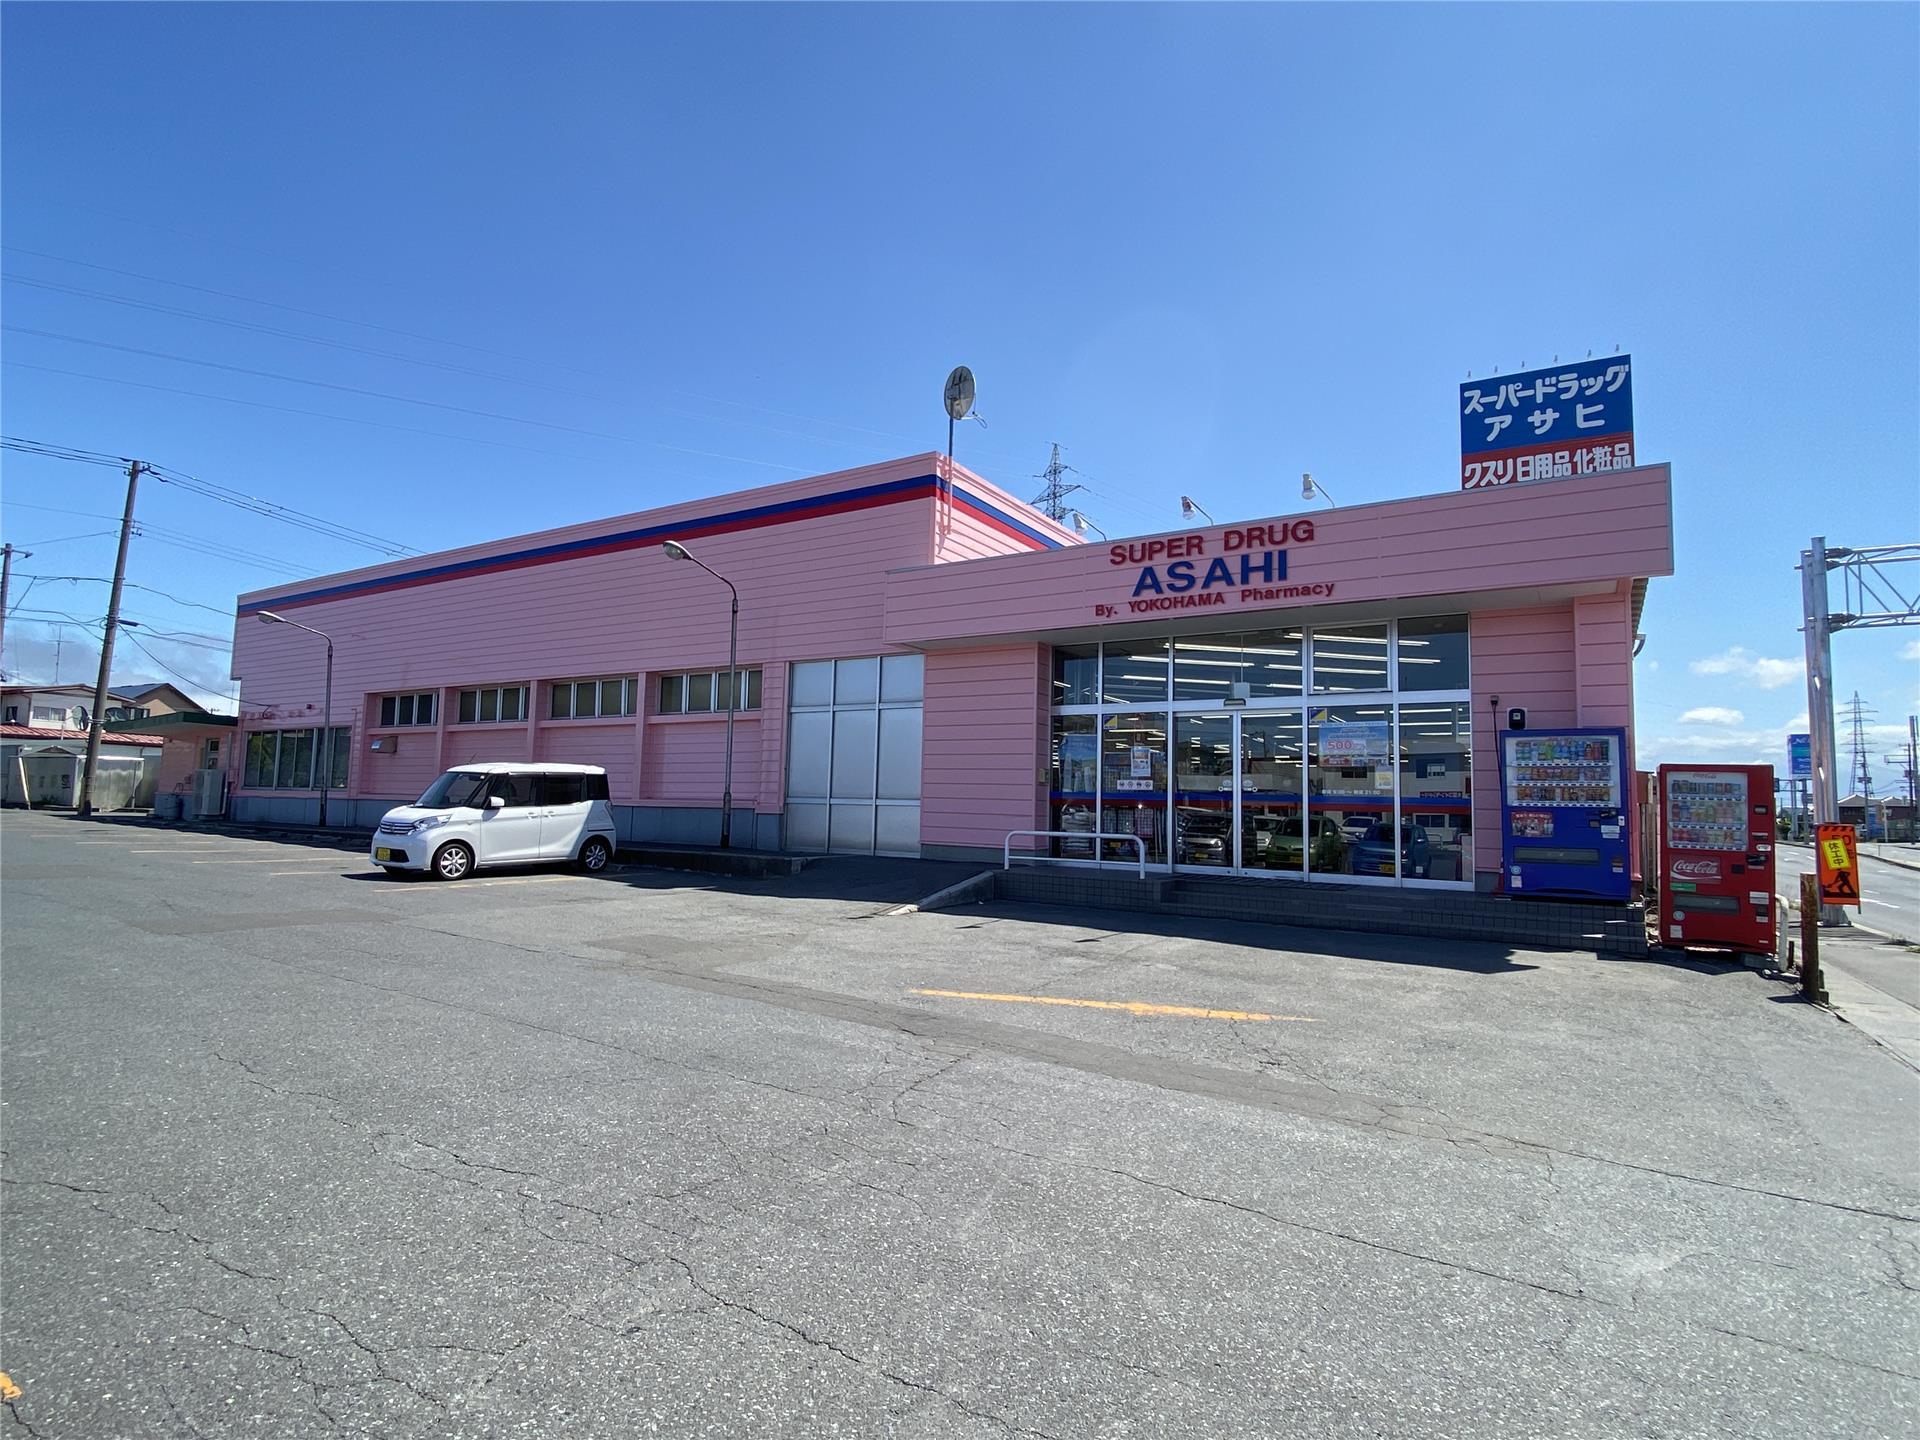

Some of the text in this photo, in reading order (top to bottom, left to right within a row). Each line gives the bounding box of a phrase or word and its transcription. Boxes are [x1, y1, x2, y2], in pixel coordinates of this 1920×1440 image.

[1464, 365, 1629, 414] スーパードラッグ
[1110, 519, 1315, 565] SUPER DRUG
[1132, 550, 1288, 597] ASAHI
[1129, 592, 1225, 614] YOKOHAMA
[1241, 583, 1335, 602] Pharmacy
